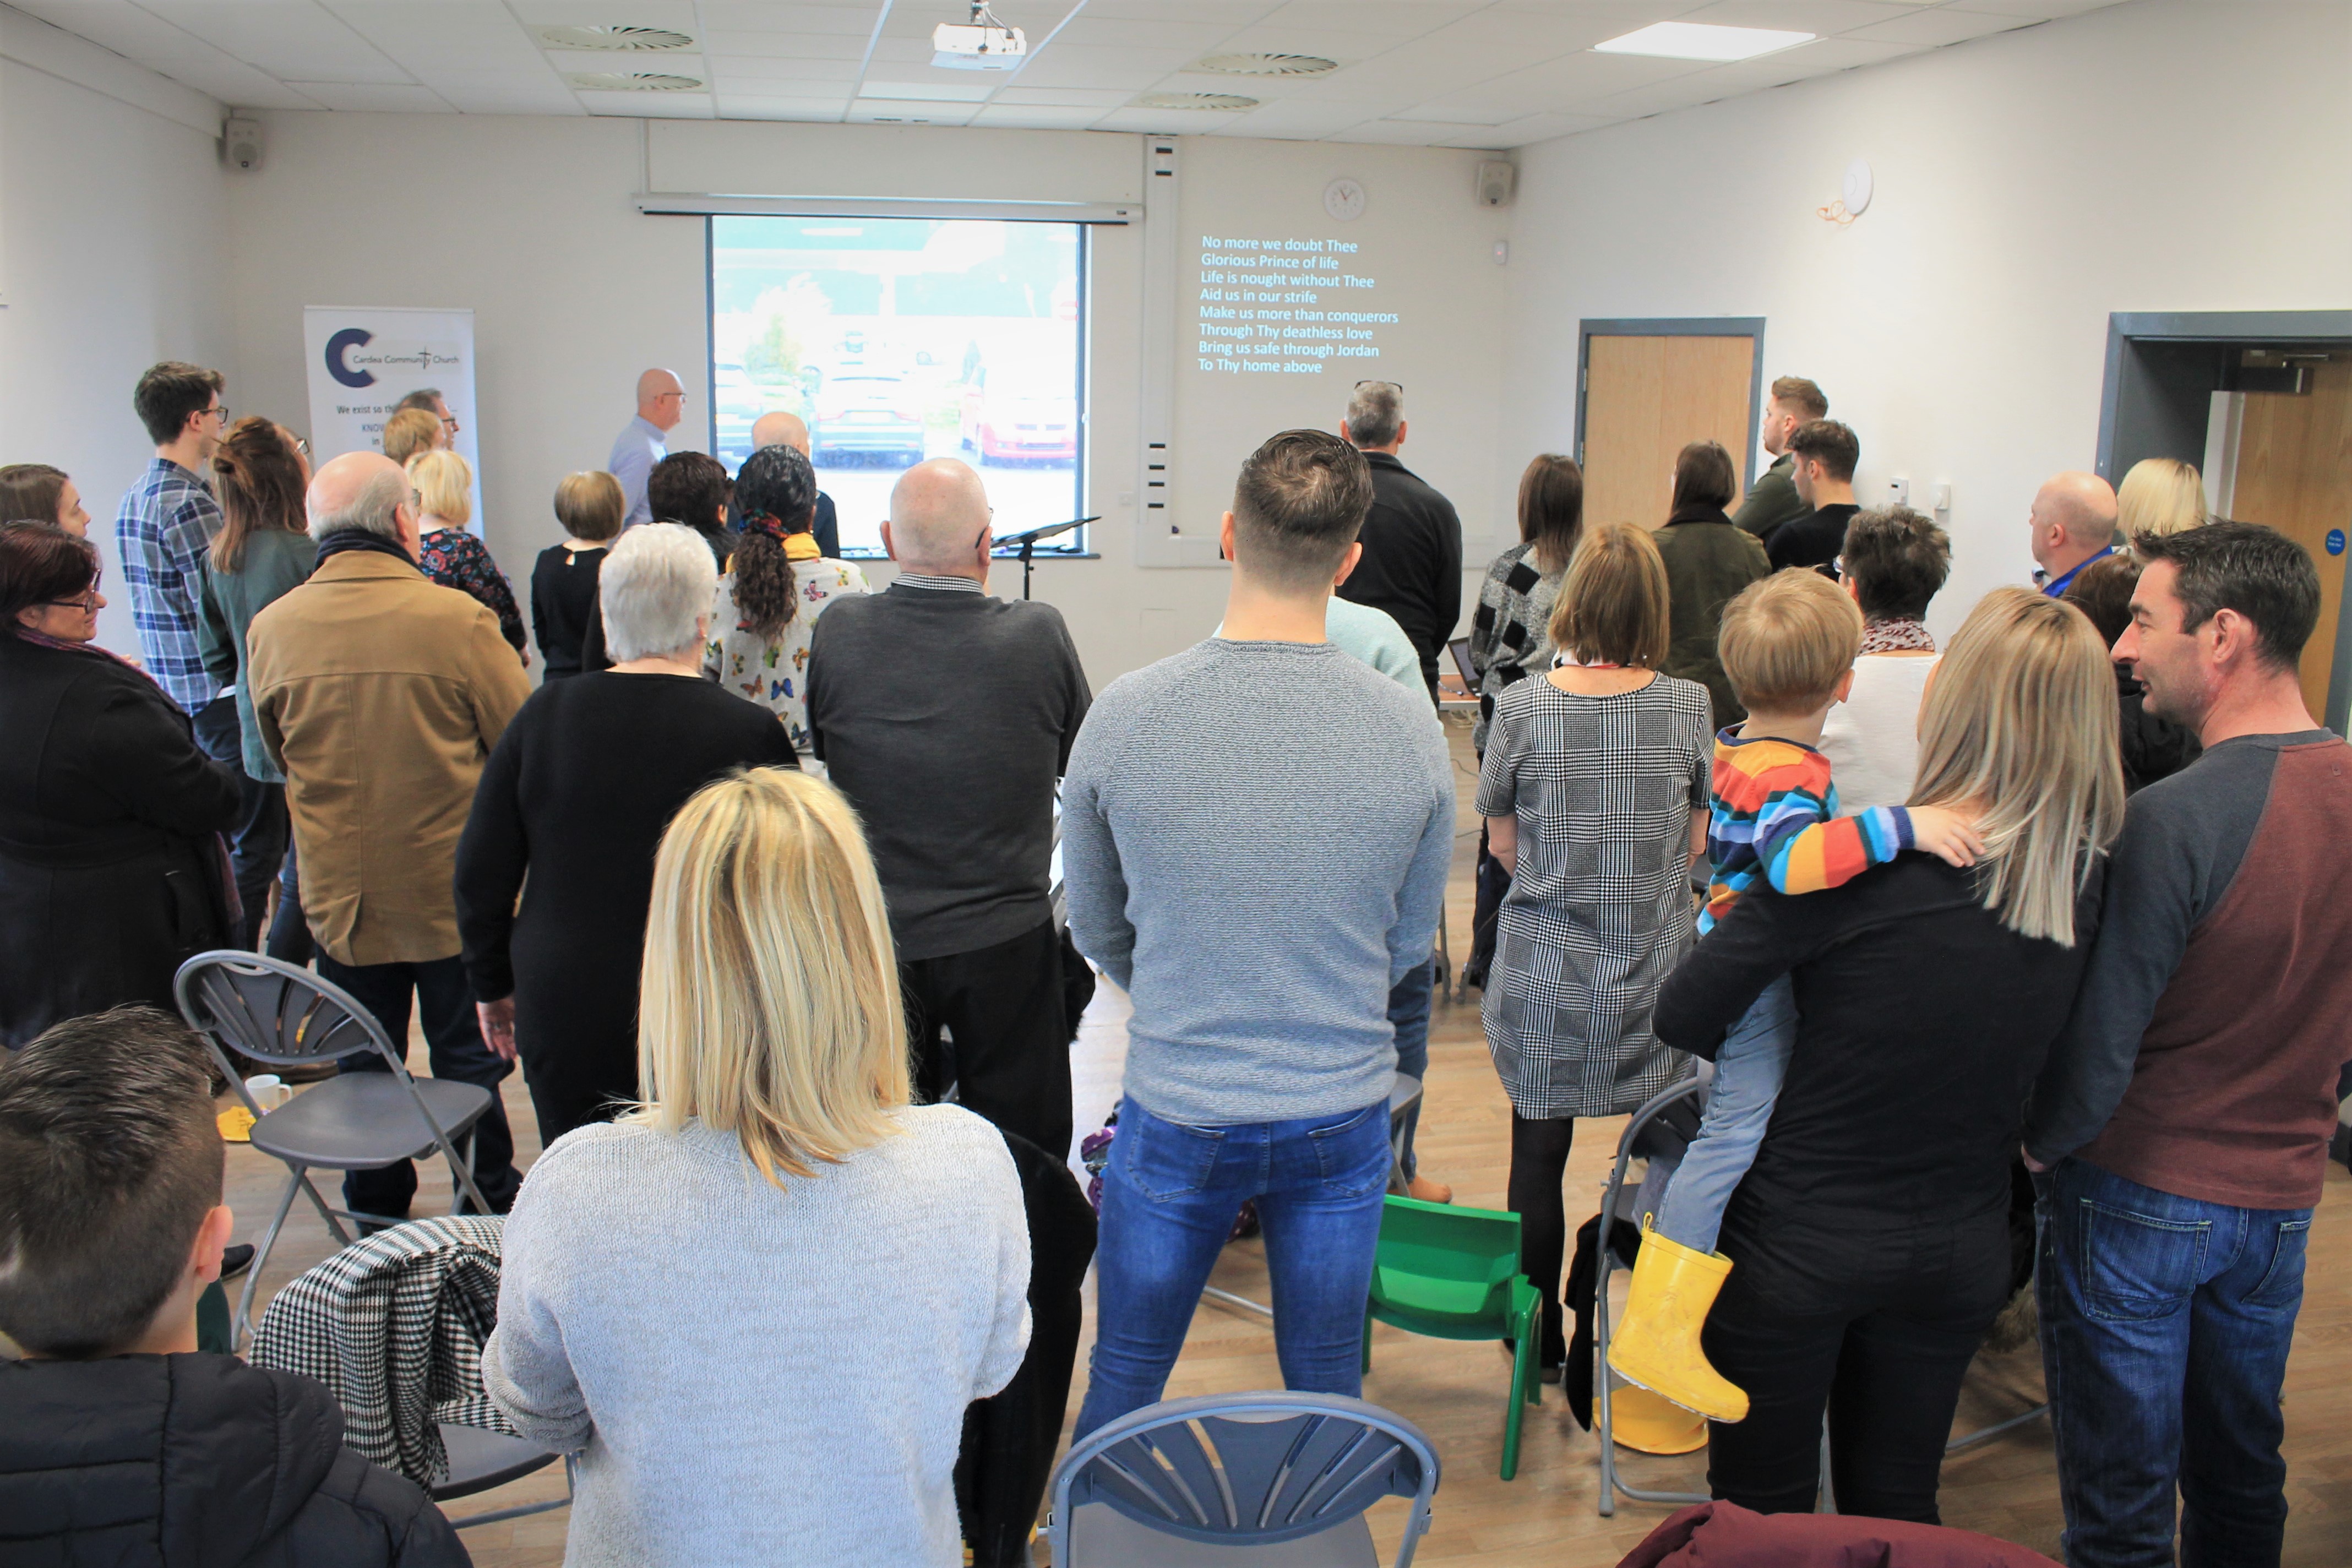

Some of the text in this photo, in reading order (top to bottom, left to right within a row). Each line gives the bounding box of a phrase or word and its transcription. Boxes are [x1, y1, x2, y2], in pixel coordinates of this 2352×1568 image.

[1202, 236, 1358, 253] No more we doubt Thee
[1201, 253, 1339, 270] Glorious Prince of life
[1201, 271, 1375, 288] Life is nought without Thee
[1200, 288, 1317, 304] Aid us in our strife
[1200, 306, 1399, 324] Make us more than conquerors
[1199, 323, 1374, 340] Through Thy deathless love
[1199, 341, 1380, 358] Bring us safe through Jordan
[353, 356, 382, 364] Cardea
[433, 356, 459, 364] Church
[1198, 358, 1322, 374] To Thy home above
[337, 406, 350, 414] We
[352, 406, 371, 414] exist
